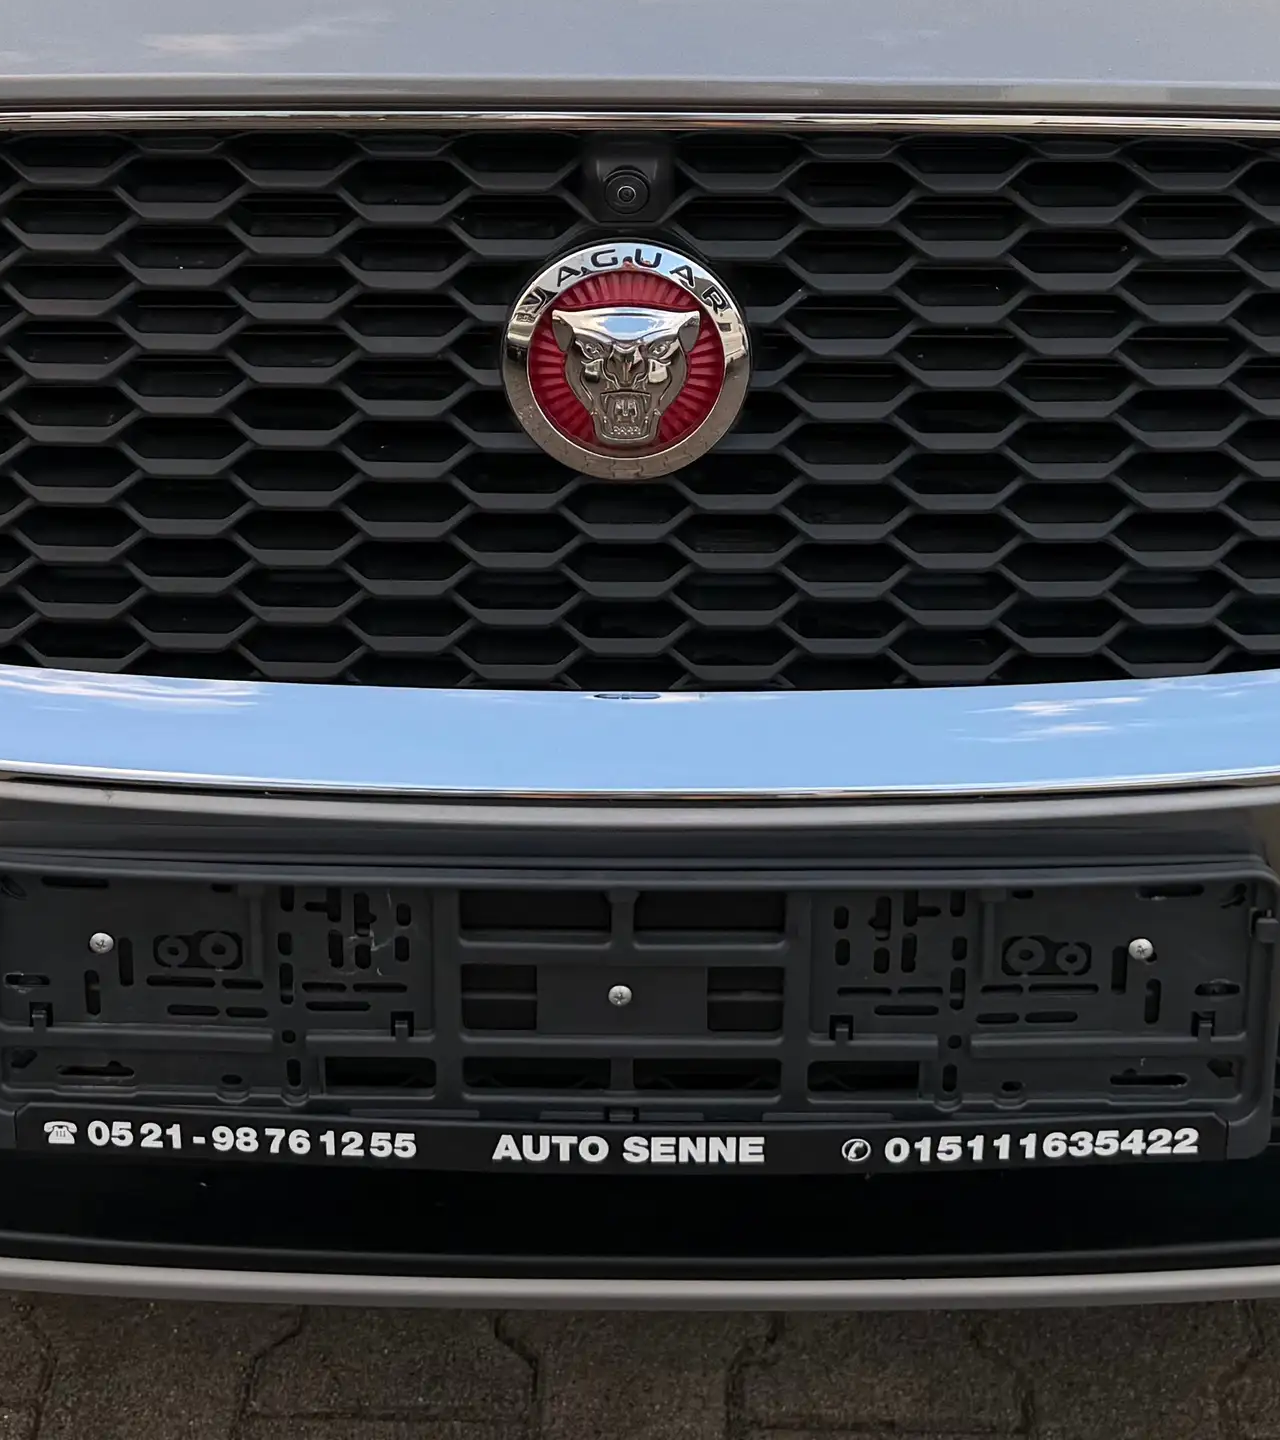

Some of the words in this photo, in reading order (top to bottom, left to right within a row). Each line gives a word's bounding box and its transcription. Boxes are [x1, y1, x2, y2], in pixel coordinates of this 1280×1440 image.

[522, 247, 732, 315] JAGUAR
[491, 1134, 610, 1163] AUTO
[622, 1135, 765, 1163] SENNE
[884, 1127, 1199, 1164] 015111635422
